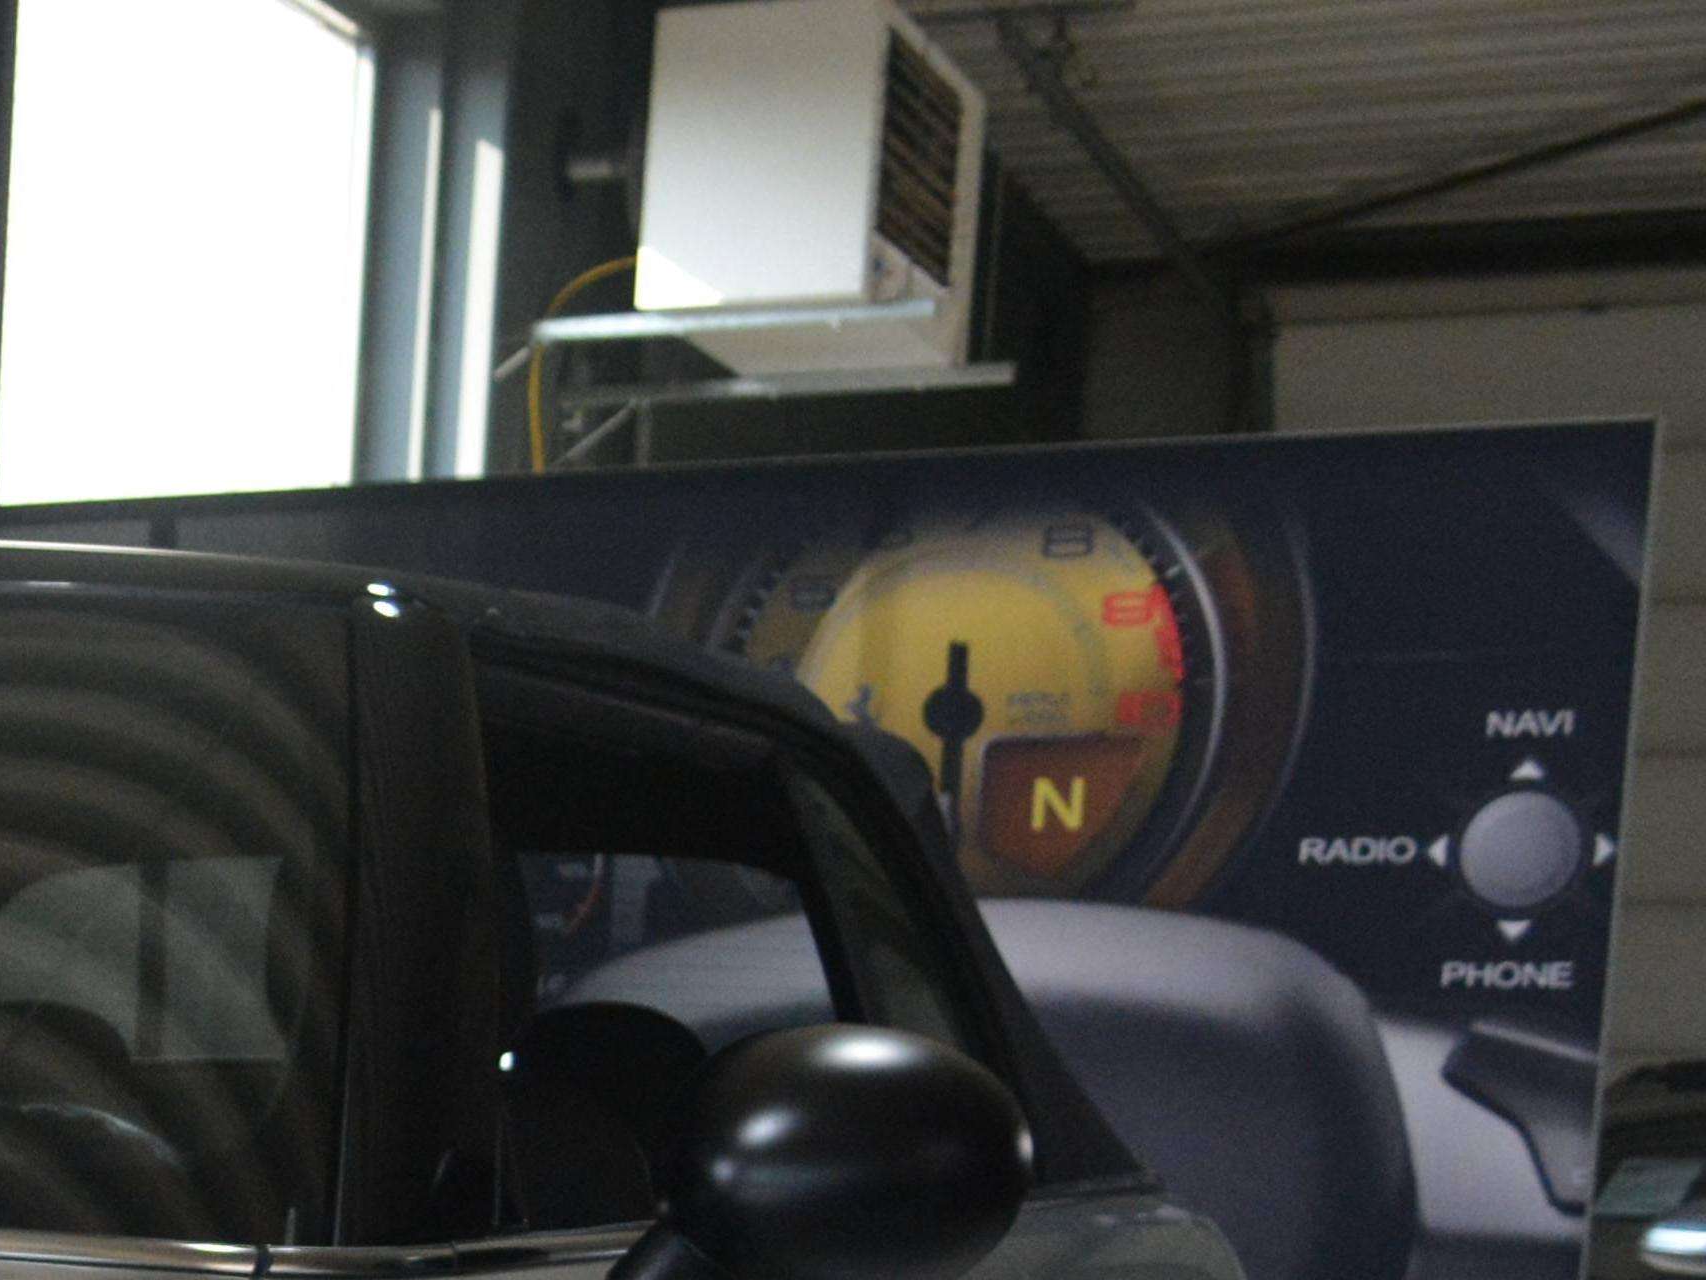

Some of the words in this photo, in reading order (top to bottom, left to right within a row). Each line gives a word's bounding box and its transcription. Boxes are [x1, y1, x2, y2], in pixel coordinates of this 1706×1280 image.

[1485, 708, 1575, 739] NAVI
[1030, 775, 1085, 832] N
[1297, 834, 1418, 866] RADIO
[1440, 960, 1575, 990] PHONE
